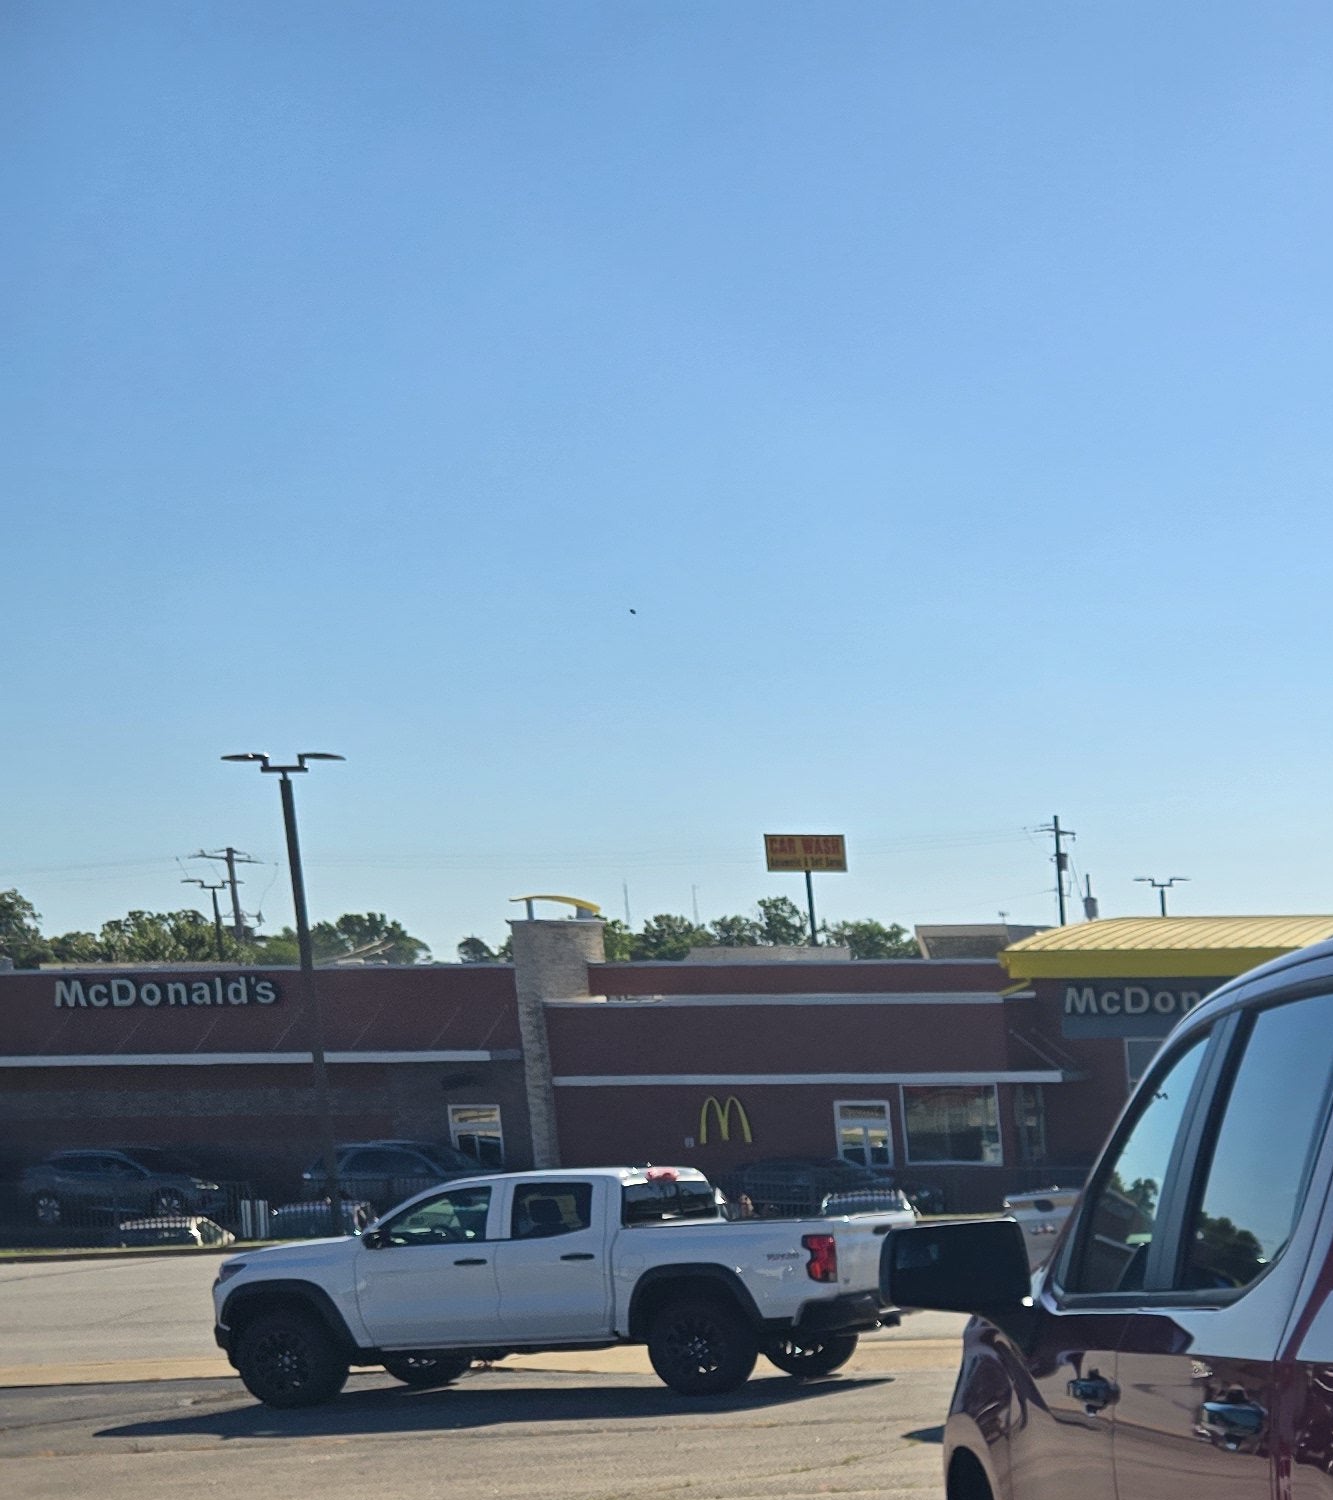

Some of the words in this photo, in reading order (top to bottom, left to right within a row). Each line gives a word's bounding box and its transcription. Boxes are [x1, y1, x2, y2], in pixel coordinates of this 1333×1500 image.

[768, 838, 796, 854] CAR
[801, 837, 840, 854] WASH
[54, 976, 276, 1008] McDonald's
